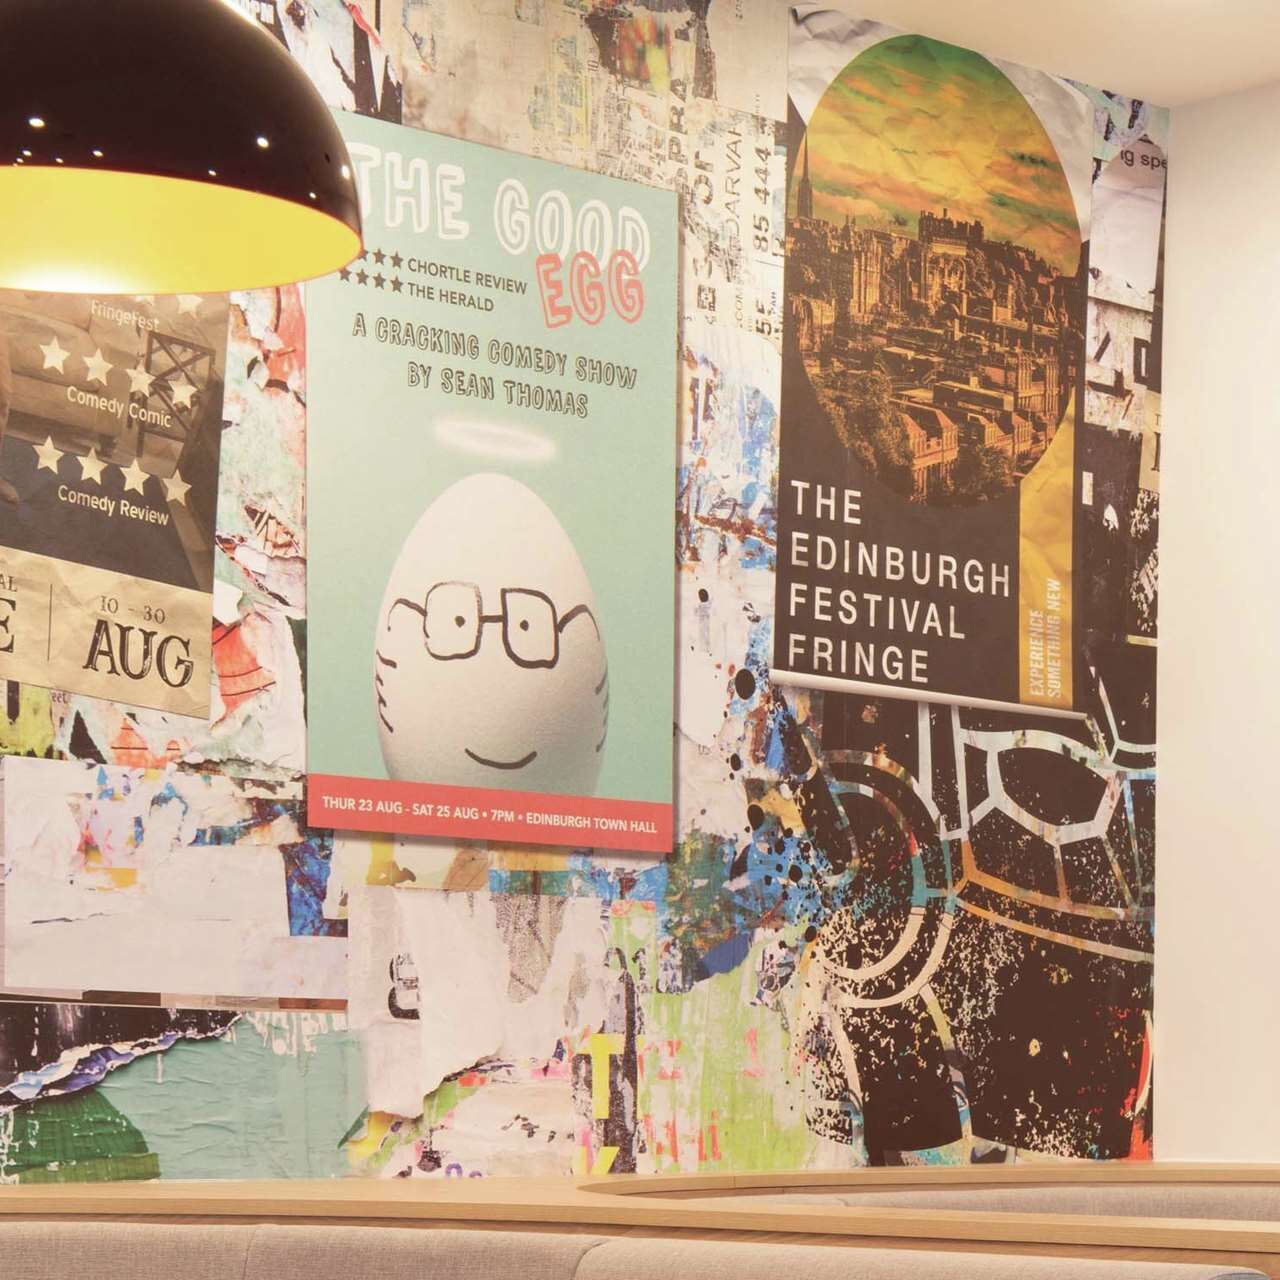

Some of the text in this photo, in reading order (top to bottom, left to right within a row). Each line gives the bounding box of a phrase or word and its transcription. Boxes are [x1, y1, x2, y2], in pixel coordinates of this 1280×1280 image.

[346, 142, 470, 240] THE
[494, 178, 651, 276] GOOD
[407, 258, 528, 296] CHORTLE REVIEW
[408, 281, 495, 312] THE HERALD
[536, 249, 645, 329] EGG
[352, 313, 638, 391] A CRACKING COMEDY SHOW
[66, 384, 172, 429] Comedy Comic
[408, 362, 589, 419] BY SEAN THOMAS
[57, 485, 170, 527] Comedy Review
[790, 479, 862, 526] THE
[790, 532, 1011, 598] EDINBURGH
[144, 604, 166, 624] 30
[789, 583, 967, 640] FESTIVAL
[1047, 577, 1062, 611] NEW
[83, 619, 194, 688] AUG
[788, 632, 930, 684] FRINGE
[1029, 607, 1045, 697] EXPERIENCE
[322, 796, 356, 812] THUR
[358, 799, 374, 813] 23
[376, 801, 403, 815] AUG
[412, 803, 434, 817] SAT
[437, 804, 451, 819] 25
[454, 806, 480, 820] AUG
[491, 808, 515, 822] 7PM
[526, 812, 592, 829] EDINBURGH
[594, 818, 628, 832] TOWN
[630, 819, 658, 834] HALL
